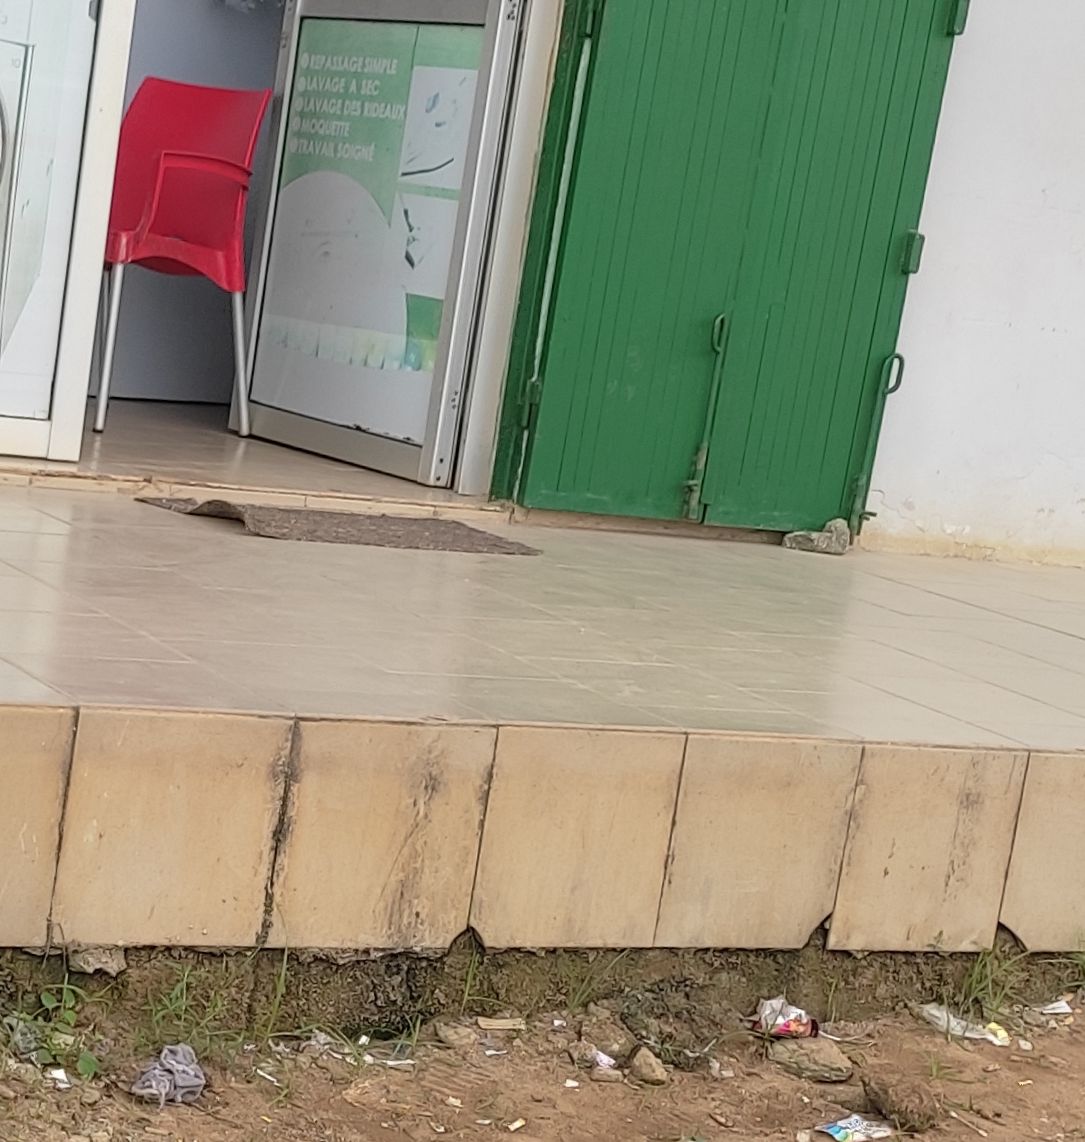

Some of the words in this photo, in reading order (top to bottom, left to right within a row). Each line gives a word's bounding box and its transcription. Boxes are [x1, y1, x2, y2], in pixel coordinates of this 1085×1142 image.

[309, 54, 363, 73] REPASSAGE
[363, 57, 398, 75] SIMPLE
[306, 76, 346, 93] LAVAGE
[360, 78, 381, 96] SEC
[303, 97, 343, 115] LAVAGE
[343, 99, 362, 116] DES
[363, 101, 406, 120] RIDEAUX
[300, 117, 351, 137] MOQUETTE
[298, 139, 335, 157] TRAVAIL
